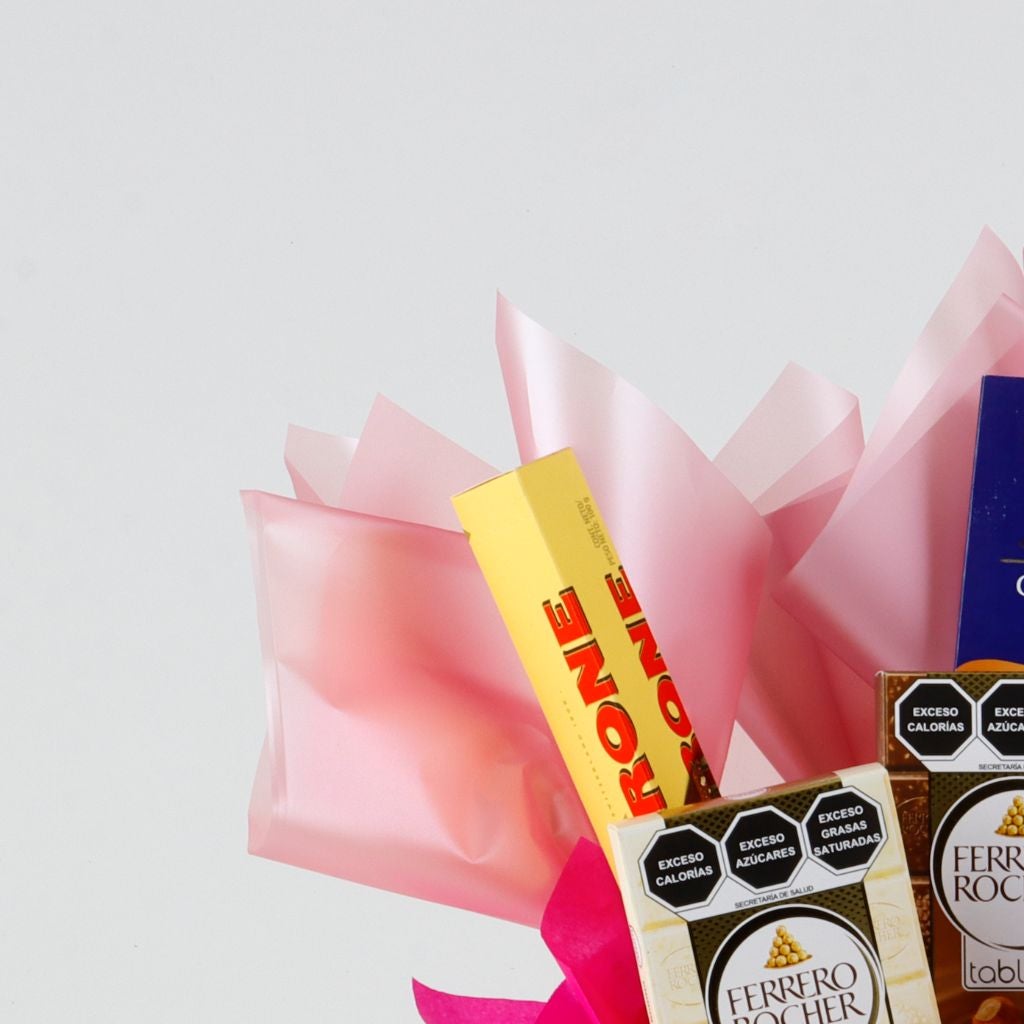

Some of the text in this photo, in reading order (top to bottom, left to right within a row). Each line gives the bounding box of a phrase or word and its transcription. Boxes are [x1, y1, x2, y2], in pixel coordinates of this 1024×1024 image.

[913, 707, 959, 717] EXCESO
[907, 720, 965, 733] CALORÍAS
[818, 804, 864, 824] EXCESO
[820, 820, 868, 839] GRASAS
[739, 832, 786, 852] EXCESO
[813, 833, 881, 858] SATURADAS
[658, 852, 705, 871] EXCESO
[735, 846, 796, 869] AZÚCARES
[655, 865, 713, 887] CALORÍAS
[778, 891, 789, 899] DE
[789, 885, 814, 897] SALUD
[726, 962, 858, 1016] FERRERO
